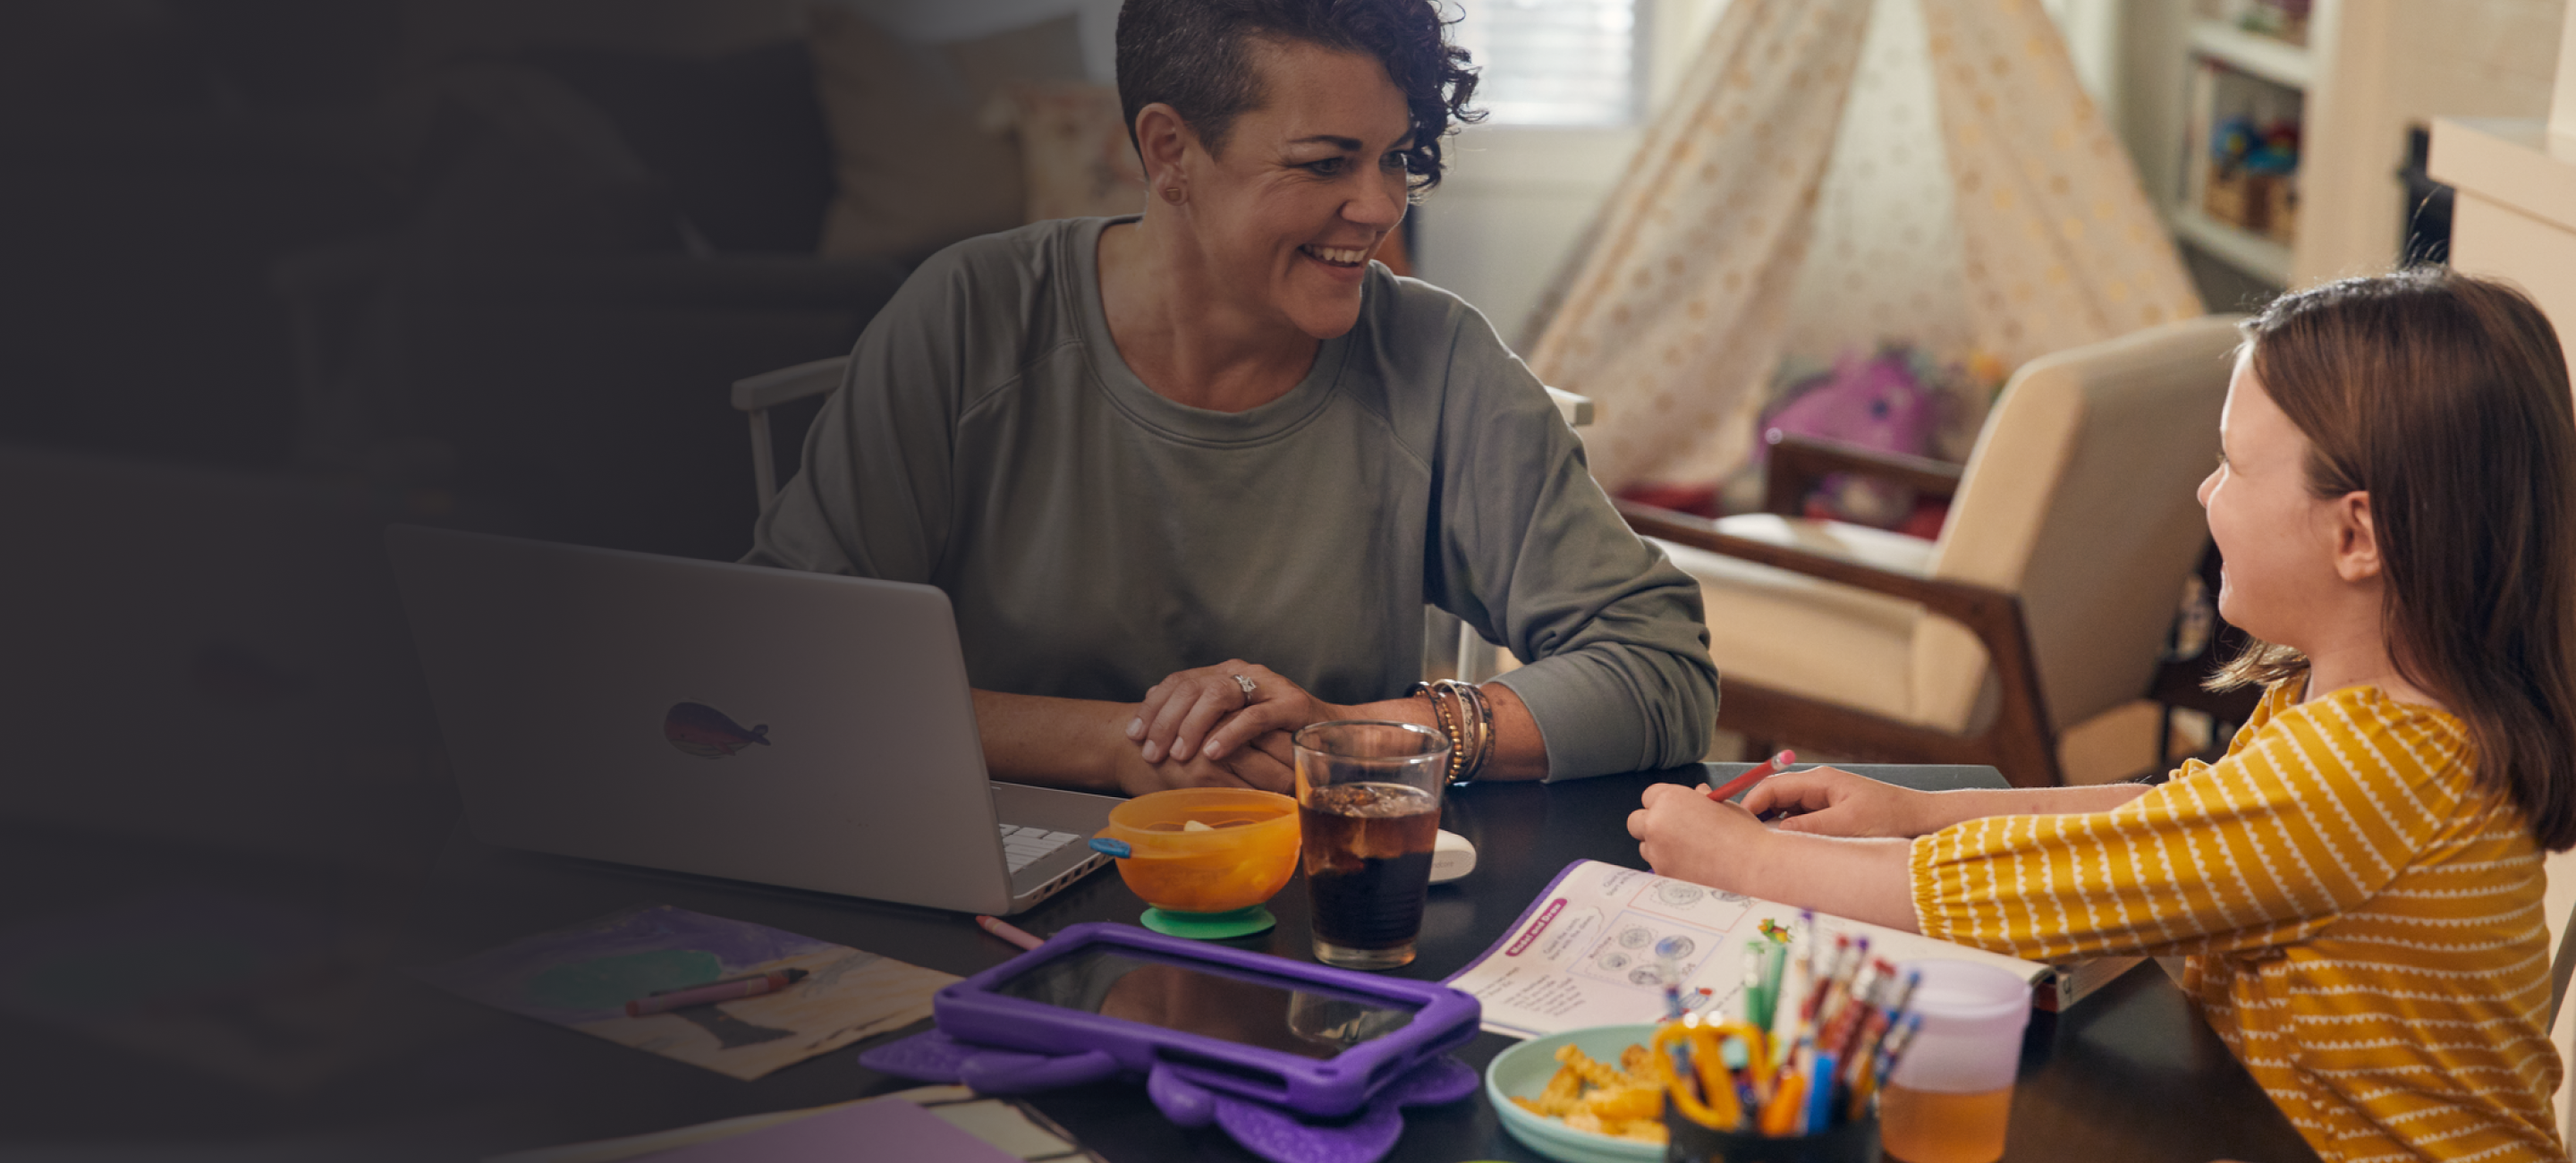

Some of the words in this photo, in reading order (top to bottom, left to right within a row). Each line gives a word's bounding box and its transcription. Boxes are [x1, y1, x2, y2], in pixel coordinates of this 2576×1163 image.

[1509, 933, 1532, 954] Model
[1530, 921, 1546, 934] and
[1539, 903, 1562, 923] Draw
